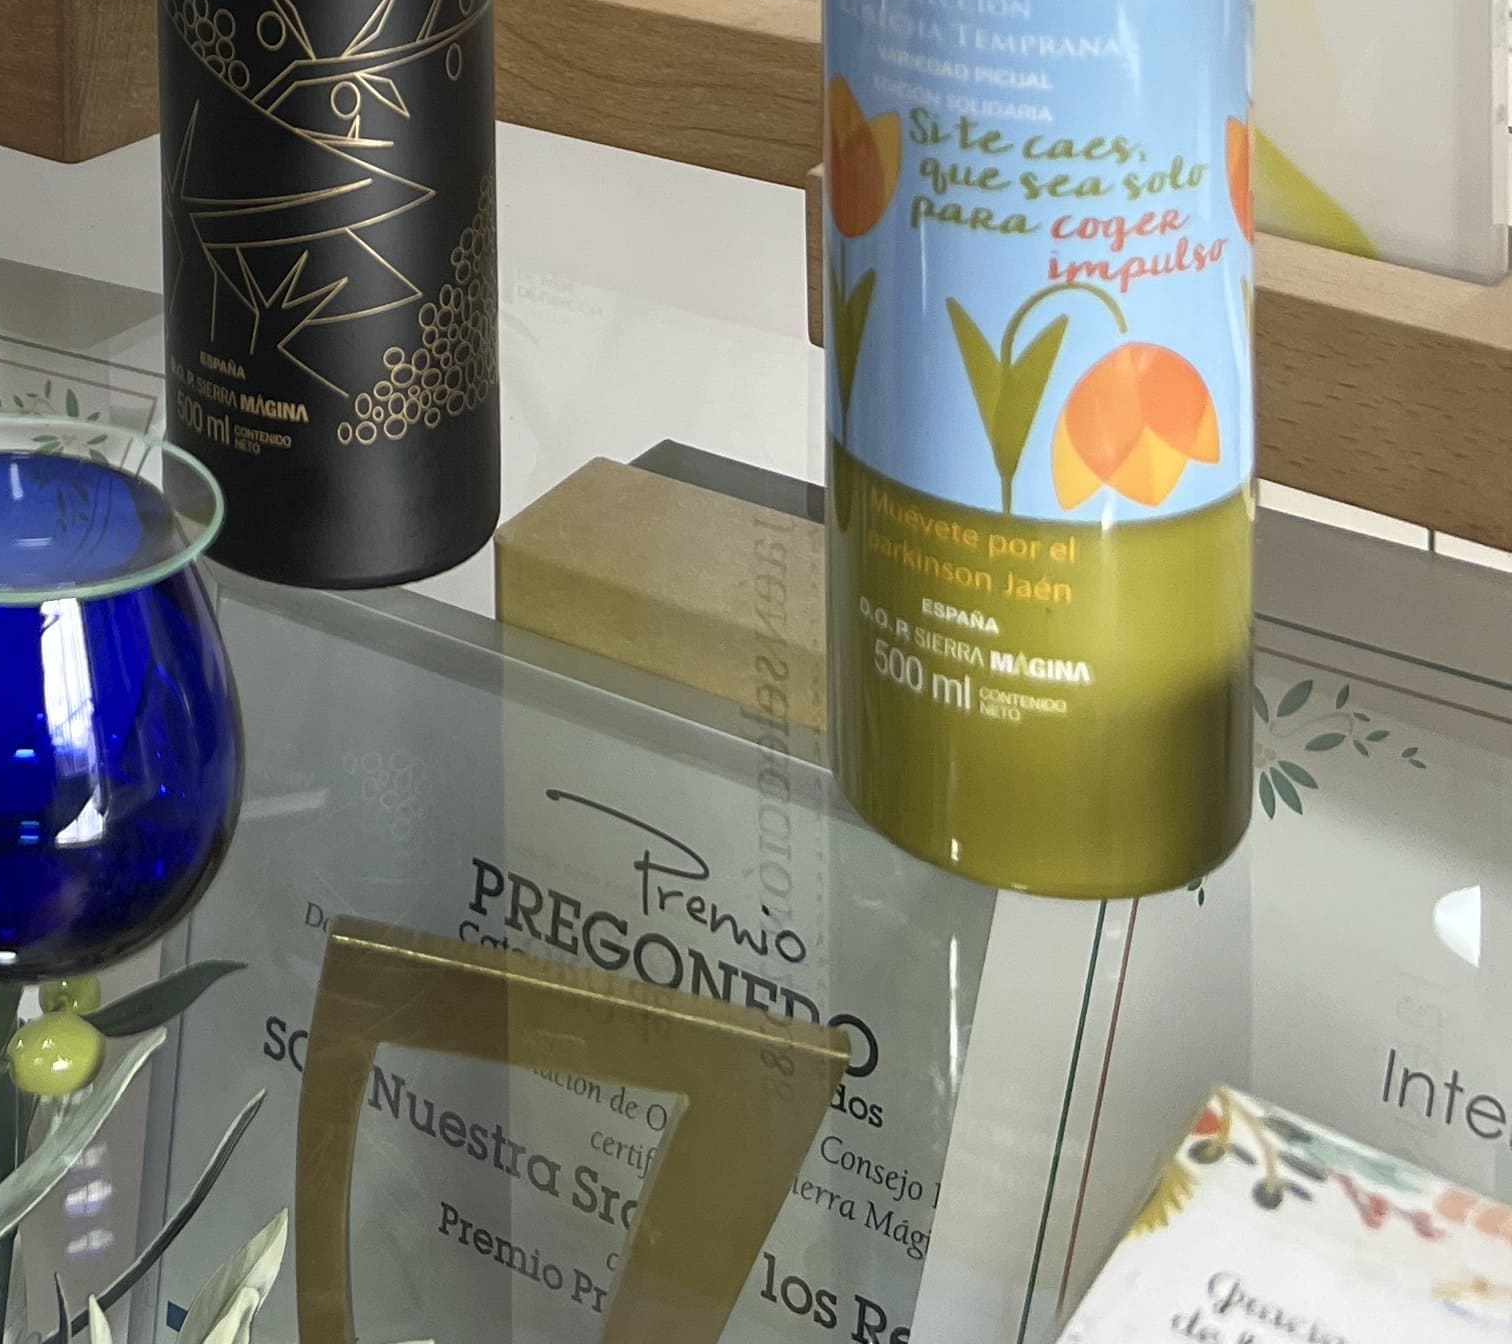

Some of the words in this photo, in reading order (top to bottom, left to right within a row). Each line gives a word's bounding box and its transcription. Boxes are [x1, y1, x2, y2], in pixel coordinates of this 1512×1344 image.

[879, 44, 968, 82] VARIEDAD
[974, 66, 1053, 90] PICUAL
[956, 115, 1014, 156] te
[918, 157, 1012, 195] que
[1020, 168, 1113, 201] sea
[1122, 154, 1210, 200] solo
[1047, 236, 1230, 295] impulso
[200, 350, 246, 381] ESPAÑA
[177, 389, 203, 434] 500
[207, 414, 230, 446] ml
[234, 424, 292, 449] CONTENIDO
[240, 393, 310, 424] MÁGINA
[234, 437, 261, 456] NETO
[870, 486, 979, 549] Muévete
[990, 532, 1040, 561] por
[1050, 535, 1076, 563] el
[1003, 571, 1073, 604] Jaén
[921, 597, 1000, 636] ESPAÑA
[873, 638, 925, 696] 500
[932, 670, 972, 711] ml
[979, 686, 1068, 714] CONTENIDO
[914, 627, 985, 669] SIERRA
[989, 648, 1092, 684] MÁGINA
[979, 702, 1021, 722] NETO
[545, 789, 807, 964] Premio
[610, 1083, 638, 1120] de
[368, 1064, 561, 1199] Nuestra
[820, 1135, 923, 1202] Consejo
[438, 1201, 563, 1291] Premio
[761, 1251, 838, 1330] los
